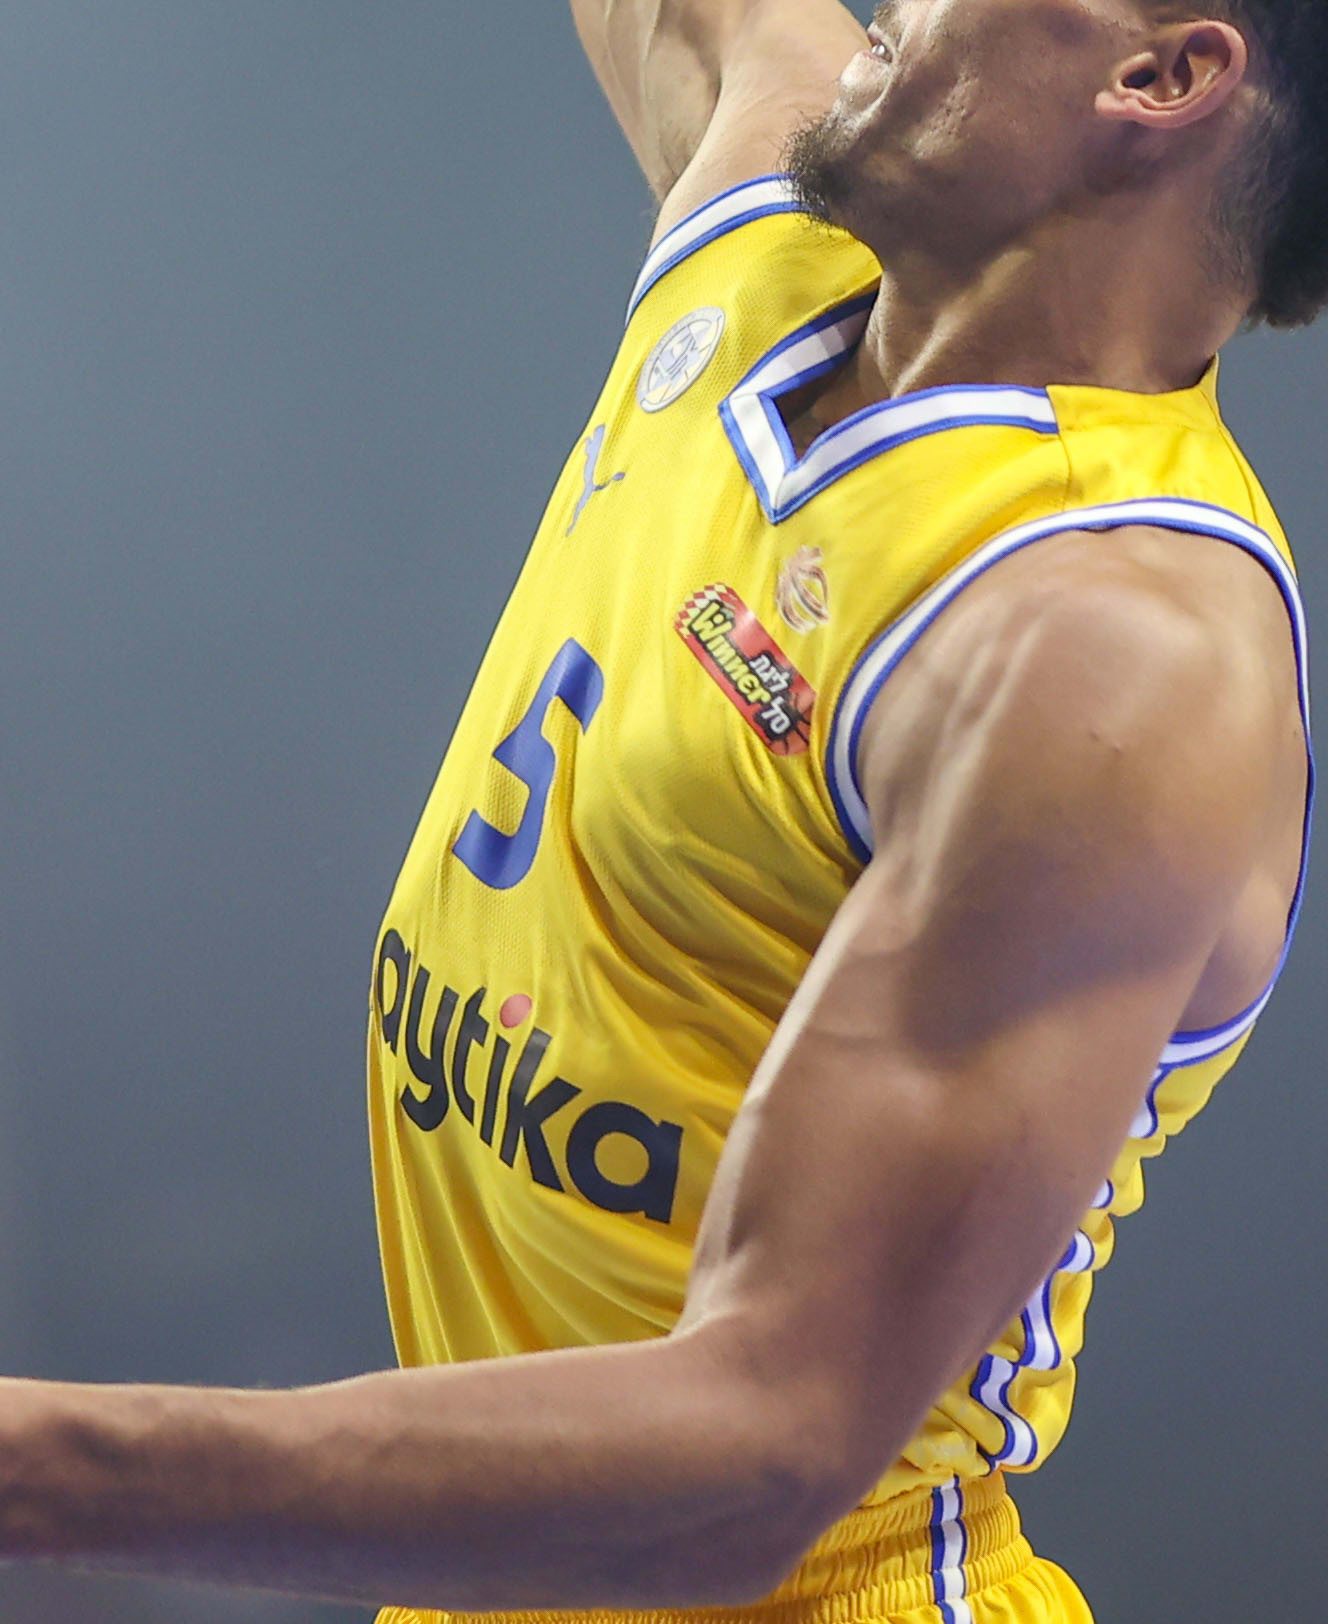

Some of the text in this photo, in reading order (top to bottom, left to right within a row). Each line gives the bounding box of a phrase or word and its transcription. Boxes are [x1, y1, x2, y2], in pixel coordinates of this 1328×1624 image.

[452, 637, 604, 889] 5
[689, 601, 792, 735] Winner סל
[749, 653, 791, 693] ליגת
[377, 928, 684, 1224] aytika
